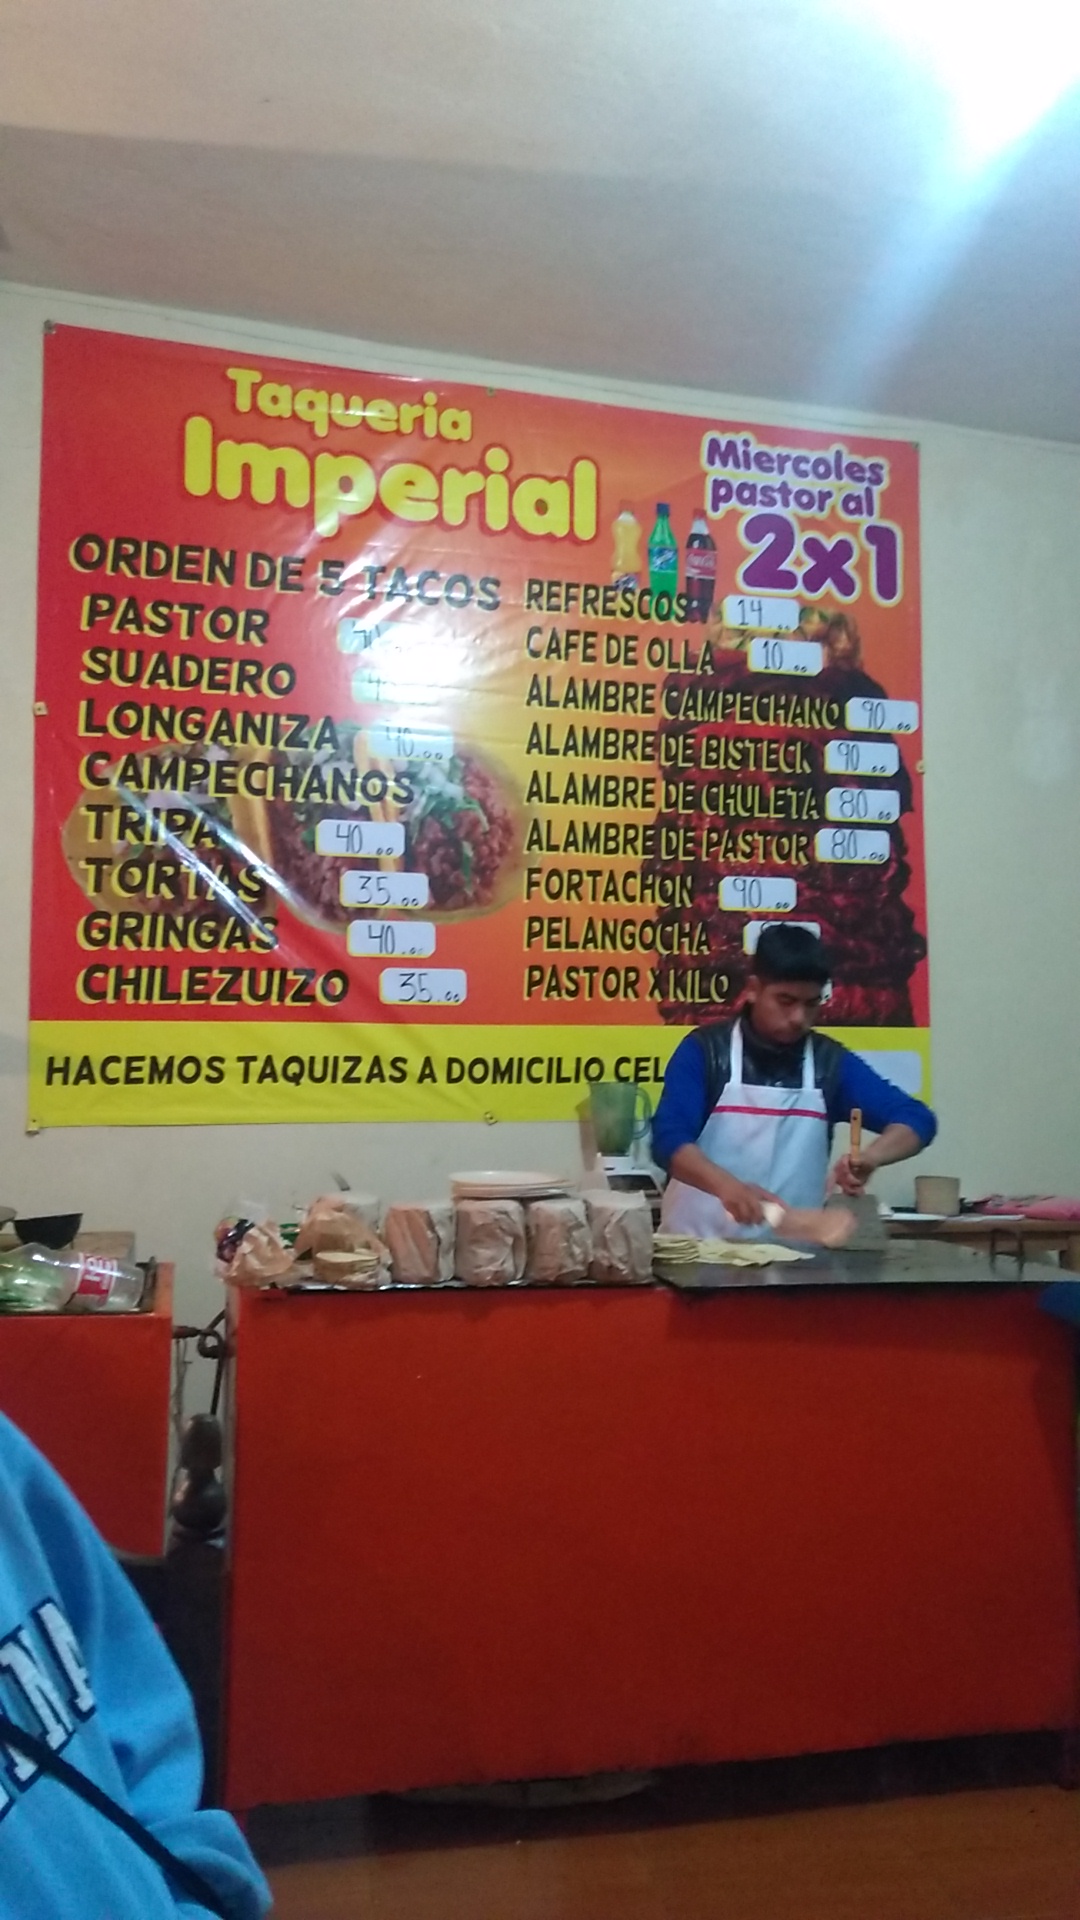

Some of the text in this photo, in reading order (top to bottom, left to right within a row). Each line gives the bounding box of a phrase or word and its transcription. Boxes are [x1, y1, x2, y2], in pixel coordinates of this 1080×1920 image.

[226, 367, 472, 442] Taqueria
[184, 416, 597, 540] Imperial
[706, 435, 885, 487] Miercoles
[711, 477, 874, 517] pastor al
[70, 533, 501, 612] ORDEN DE 5 TACOS
[742, 513, 899, 602] 2x1
[80, 593, 269, 647] PASTOR
[525, 578, 689, 625] REFRESCOS
[80, 646, 297, 699] SUADERO
[526, 626, 714, 675] CAFE DE OLLA
[77, 699, 340, 752] LONGANIZA
[525, 674, 840, 730] ALAMBRE CAMPECHANO
[526, 722, 812, 774] ALAMBRE DE BISTECK
[78, 751, 415, 806] CAMPECHANOS
[526, 770, 820, 820] ALAMBRE DE CHULETA
[80, 804, 220, 850] TRIPA
[525, 819, 810, 865] ALAMBRE DE PASTOR
[80, 857, 267, 903] TORTAS
[524, 867, 693, 909] FORTACHON
[77, 910, 279, 952] GRINGAS
[524, 916, 710, 956] PELANGOCHA
[77, 964, 349, 1005] CHILEZUIZO
[524, 964, 730, 1004] PASTOR X KILO
[45, 1055, 226, 1086] HACEMOS
[237, 1055, 409, 1086] TAQUIZAS
[416, 1058, 438, 1085] A
[446, 1056, 605, 1085] DOMICILIO
